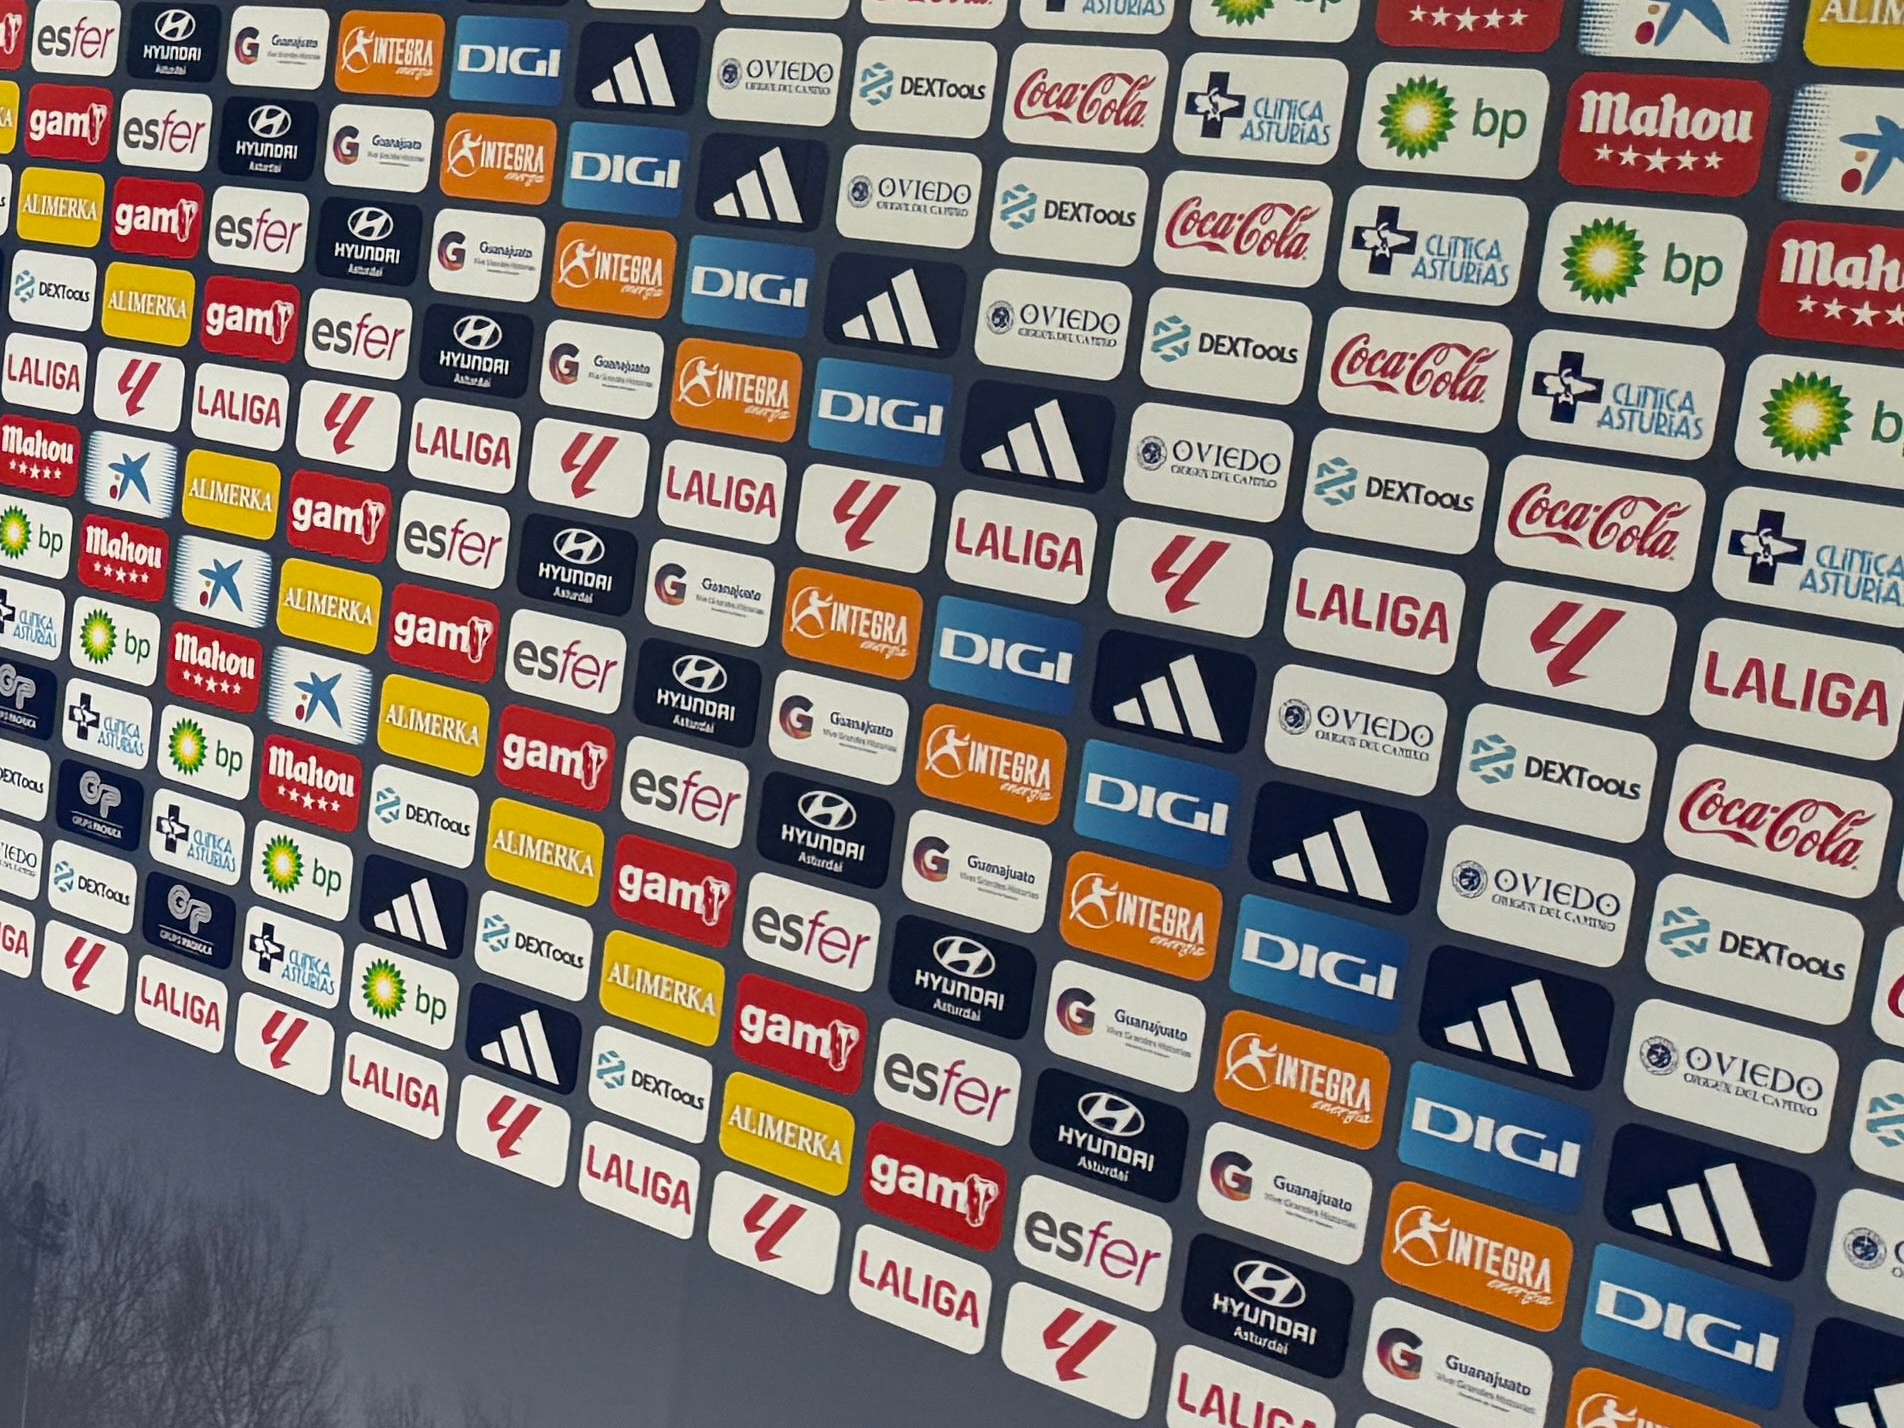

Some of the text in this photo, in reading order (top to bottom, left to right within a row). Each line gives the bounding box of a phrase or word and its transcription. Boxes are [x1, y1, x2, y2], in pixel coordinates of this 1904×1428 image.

[38, 17, 114, 58] esfer
[455, 44, 560, 77] DIGI
[747, 60, 833, 84] OVIEDO
[1014, 68, 1156, 127] Coca-Cola
[1580, 90, 1753, 143] Mahou
[1472, 98, 1527, 148] bp
[568, 151, 680, 188] DIGI
[879, 178, 971, 204] OVIEDO
[215, 208, 302, 254] esfer
[1165, 196, 1320, 259] Coca-Cola
[691, 265, 808, 307] DIGI
[1663, 242, 1723, 296] bp
[103, 285, 187, 318] ALIMERKA
[1020, 304, 1120, 334] OVIEDO
[312, 313, 405, 361] esfer
[8, 354, 79, 392] LALIGA
[714, 366, 789, 408] INTEGRA
[1331, 333, 1499, 402] Coca-Cola
[198, 386, 280, 428] LALIGA
[818, 389, 943, 435] DIGI
[2, 425, 73, 464] Mahou
[416, 422, 510, 469] LALIGA
[1173, 440, 1281, 475] OVIEDO
[667, 466, 776, 518] LALIGA
[39, 524, 63, 557] bp
[404, 519, 502, 569] esfer
[1508, 483, 1691, 559] Coca-Cola
[86, 526, 161, 568] Mahou
[956, 518, 1083, 576] LALIGA
[280, 589, 373, 625] ALIMERKA
[1296, 578, 1448, 643] LALIGA
[1799, 568, 1904, 607] ASTURIA
[831, 602, 907, 646] INTEGRA
[175, 632, 254, 679] Mahou
[514, 640, 618, 693] esfer
[939, 627, 1072, 684] DIGI
[657, 689, 735, 721] HYUNDAI
[1704, 651, 1888, 726] LALIGA
[380, 706, 479, 745] ALIMERKA
[1318, 706, 1433, 747] OVIEDO
[216, 740, 242, 776] bp
[269, 746, 354, 797] Mahou
[968, 741, 1050, 790] INTEGRA
[630, 769, 741, 826] esfer
[1085, 772, 1228, 835] DIGI
[782, 824, 865, 861] HYUNDAI
[1679, 779, 1876, 867] Coca-Cola
[488, 826, 595, 876] ALIMERKA
[968, 855, 1035, 884] Guanajuato
[313, 858, 341, 896] bp
[1494, 869, 1620, 917] OVIEDO
[752, 907, 871, 969] esfer
[1116, 892, 1204, 944] INTEGRA
[602, 955, 716, 1016] ALIMERKA
[1241, 928, 1397, 999] DIGI
[416, 985, 446, 1024] bp
[915, 969, 1004, 1010] HYUNDAI
[1115, 1009, 1187, 1041] Guanajuato
[349, 1055, 439, 1116] LALIGA
[884, 1053, 1011, 1122] esfer
[1275, 1053, 1370, 1112] INTEGRA
[1686, 1047, 1822, 1101] OVIEDO
[730, 1106, 843, 1163] ALIMERKA
[1059, 1125, 1154, 1171] HYUNDAI
[1411, 1097, 1580, 1177] DIGI
[580, 1145, 690, 1215] LALIGA
[1274, 1176, 1352, 1211] Guanajuato
[1025, 1211, 1161, 1286] esfer
[1447, 1228, 1550, 1293] INTEGRA
[859, 1250, 979, 1328] LALIGA
[1213, 1293, 1316, 1345] HYUNDAI
[1595, 1280, 1779, 1371] DIGI
[1446, 1355, 1531, 1396] Guanajuato
